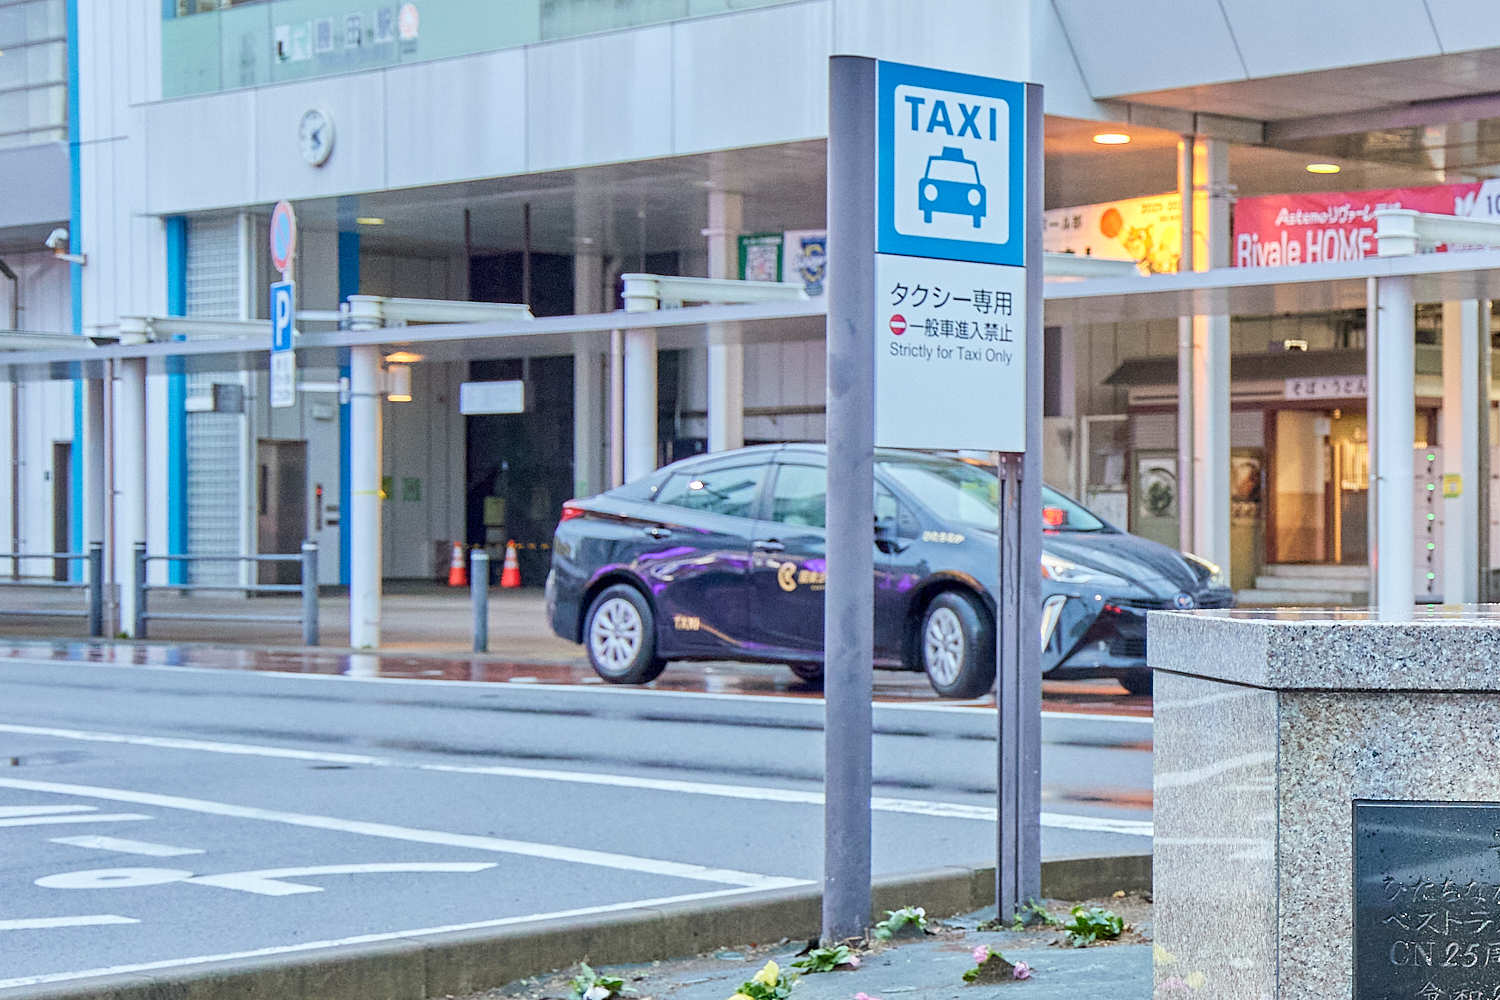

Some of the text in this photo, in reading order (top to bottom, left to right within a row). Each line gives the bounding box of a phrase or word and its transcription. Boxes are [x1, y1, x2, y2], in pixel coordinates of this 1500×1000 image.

[905, 95, 998, 143] TAXI
[1237, 229, 1301, 267] Rivale
[890, 282, 1013, 316] タクシー専用
[276, 290, 290, 347] P
[909, 318, 1013, 342] 一般車進入禁止
[890, 342, 1012, 366] Strictly for Taxi Only
